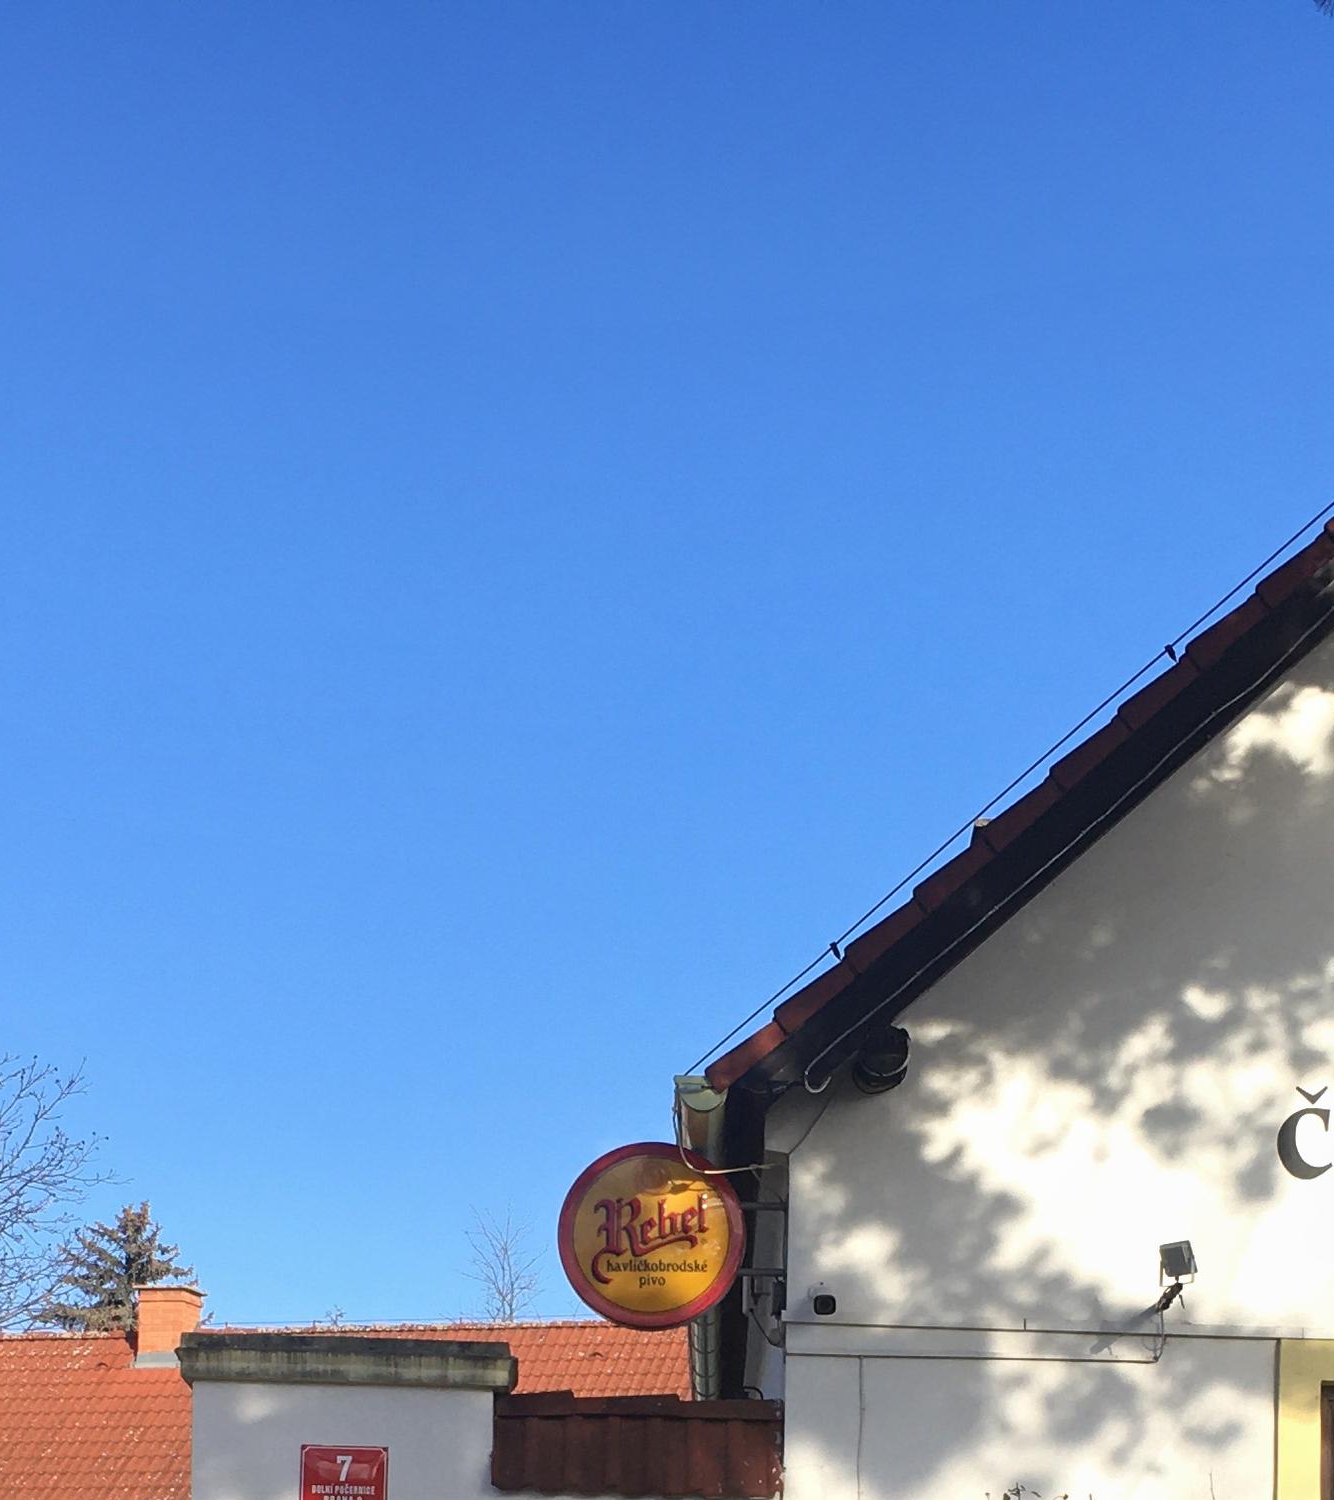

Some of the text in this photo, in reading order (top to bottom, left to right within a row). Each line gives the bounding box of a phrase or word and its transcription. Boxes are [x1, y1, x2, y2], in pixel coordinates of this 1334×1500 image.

[591, 1193, 710, 1284] Rebel
[638, 1273, 667, 1289] pivo
[336, 1455, 353, 1482] 7
[311, 1483, 376, 1495] DOLNÍ POČERNICE
